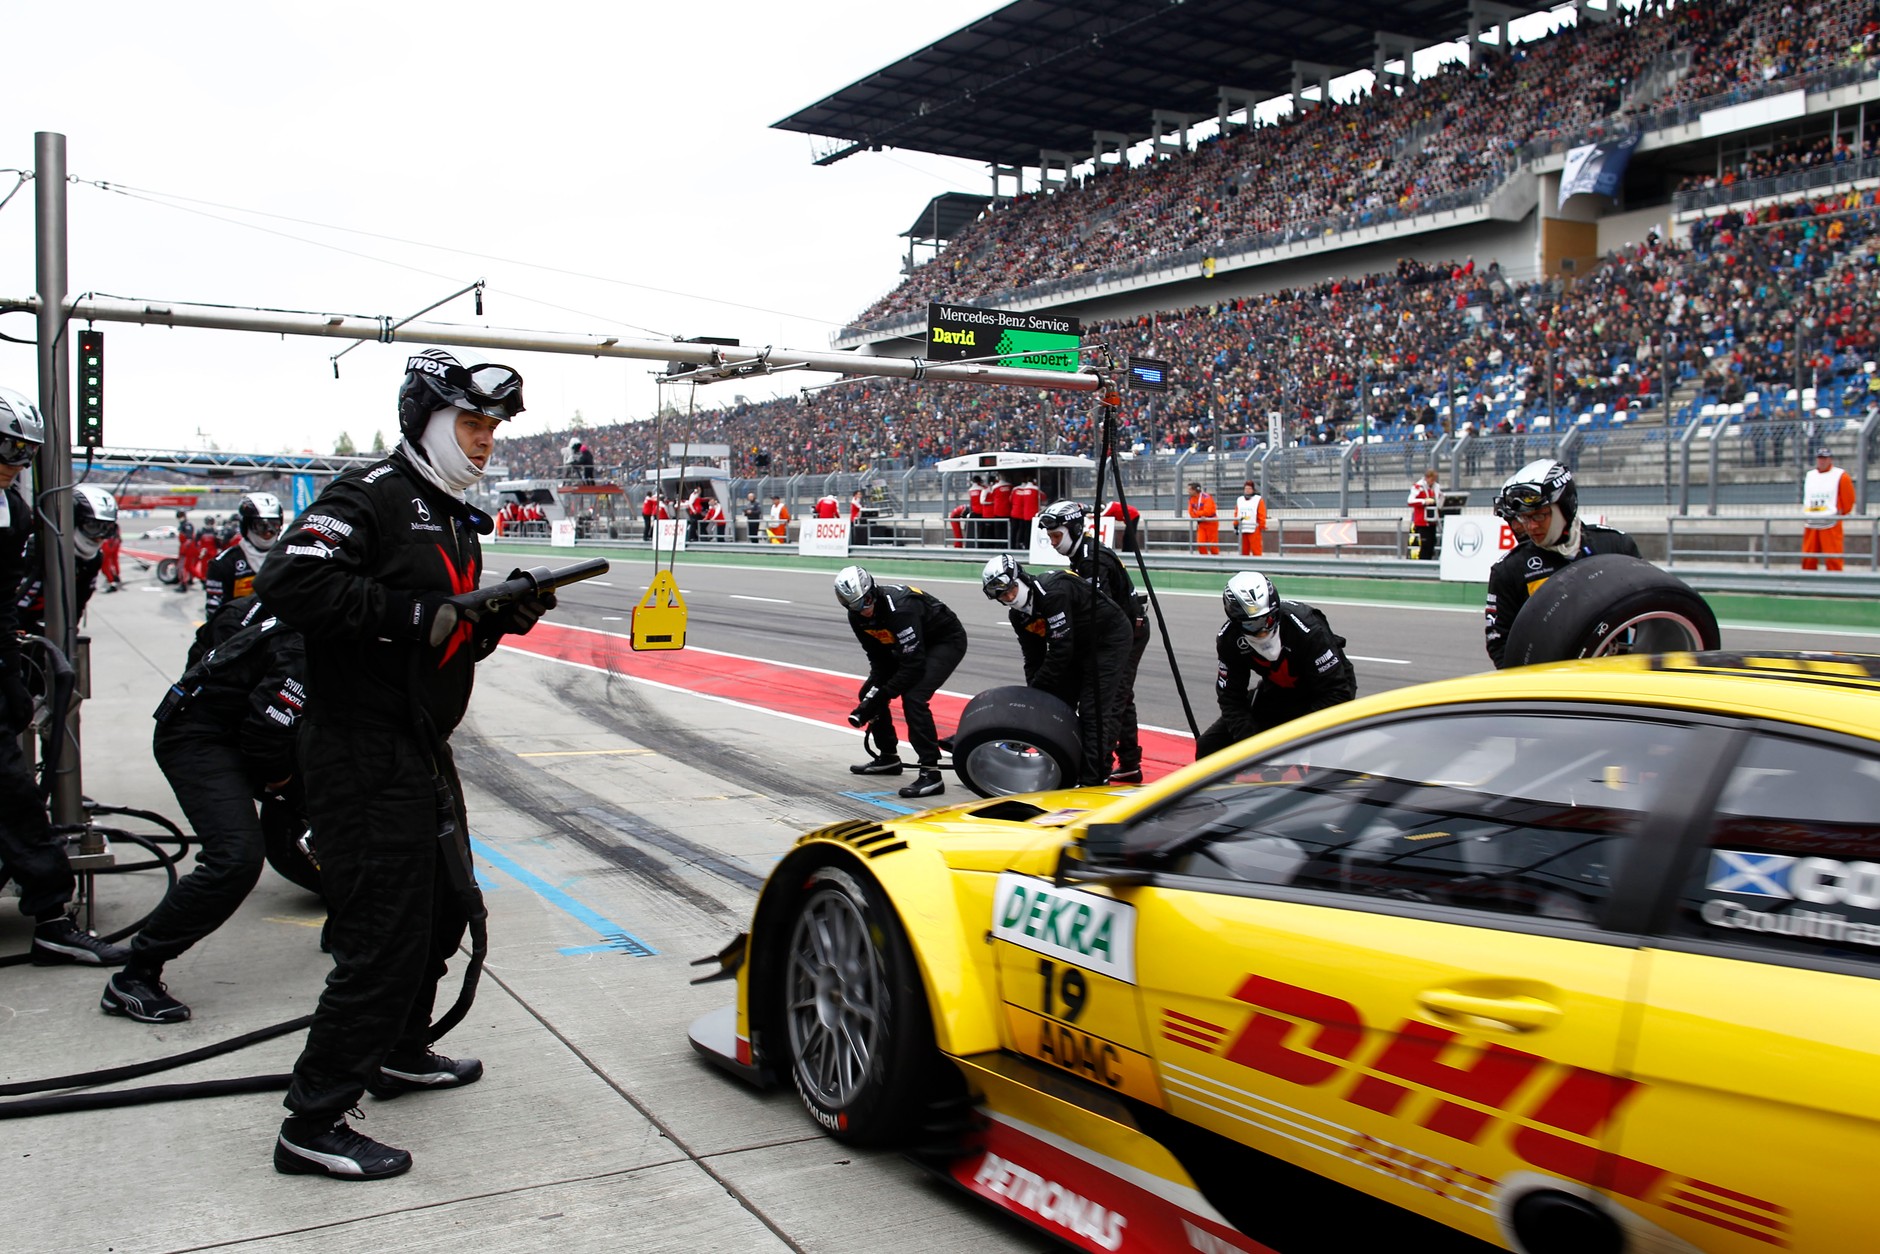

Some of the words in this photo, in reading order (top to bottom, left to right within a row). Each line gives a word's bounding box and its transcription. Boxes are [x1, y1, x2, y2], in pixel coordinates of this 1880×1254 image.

[939, 306, 1026, 329] Mercedes-Benz
[1028, 316, 1070, 333] Service
[932, 327, 976, 347] David
[408, 357, 451, 378] uvex
[1022, 350, 1070, 367] Robert
[816, 523, 846, 539] BOSCH
[285, 544, 328, 559] PUMA
[266, 705, 291, 727] PUMA
[1001, 885, 1116, 964] DEKRA
[1037, 957, 1089, 1025] 19
[1036, 1017, 1125, 1088] ADAC
[1222, 972, 1668, 1201] DHL
[973, 1151, 1128, 1252] PETRONAS
